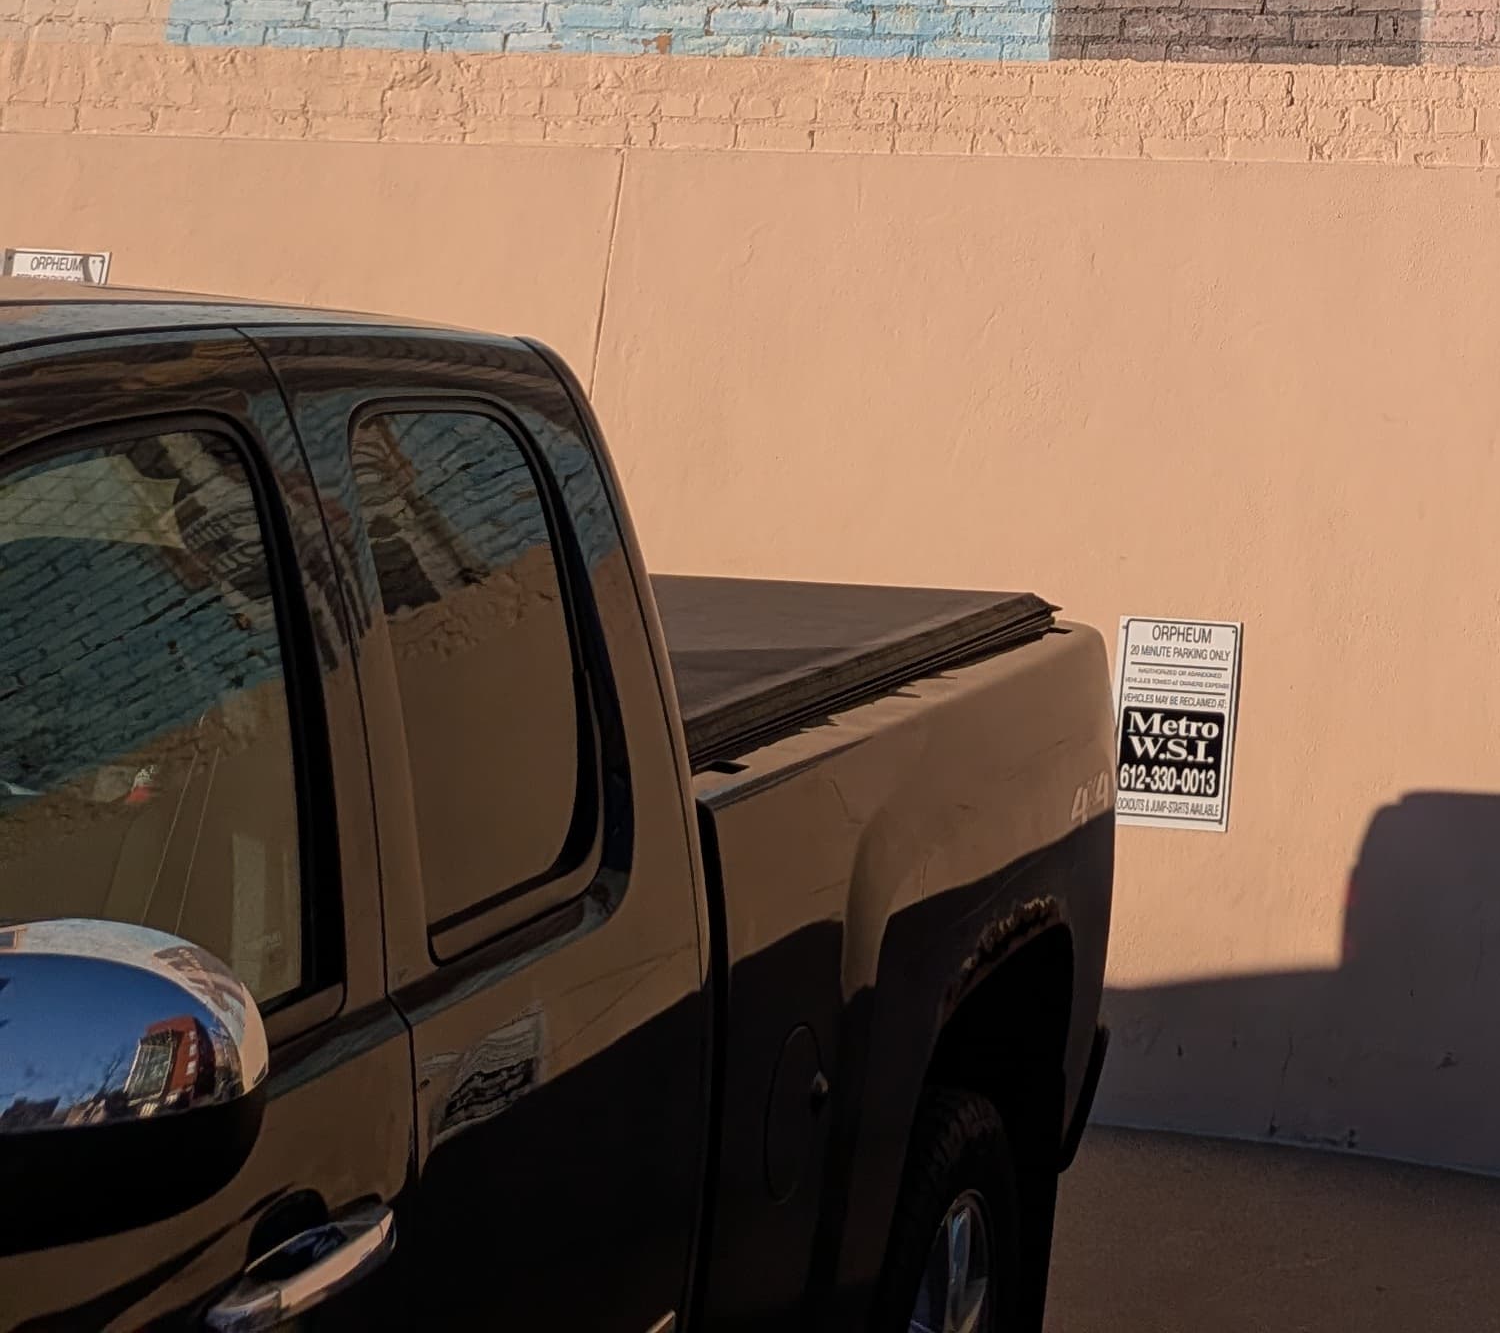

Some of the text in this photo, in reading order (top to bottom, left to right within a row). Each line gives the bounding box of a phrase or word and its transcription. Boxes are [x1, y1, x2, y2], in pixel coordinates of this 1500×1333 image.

[30, 256, 81, 271] ORPHEUM
[1152, 624, 1212, 644] ORPHEUM
[1130, 644, 1231, 661] 20 MINUTE PARKING ONLY
[1123, 693, 1154, 703] VEHICLES
[1155, 694, 1169, 704] MAY
[1169, 695, 1178, 706] BE
[1180, 696, 1216, 708] RECLAIMED
[1126, 711, 1220, 739] Metro
[1128, 735, 1214, 764] W.S.I.
[1119, 763, 1216, 795] 612-330-0013
[1116, 797, 1145, 812] OCKOUTS
